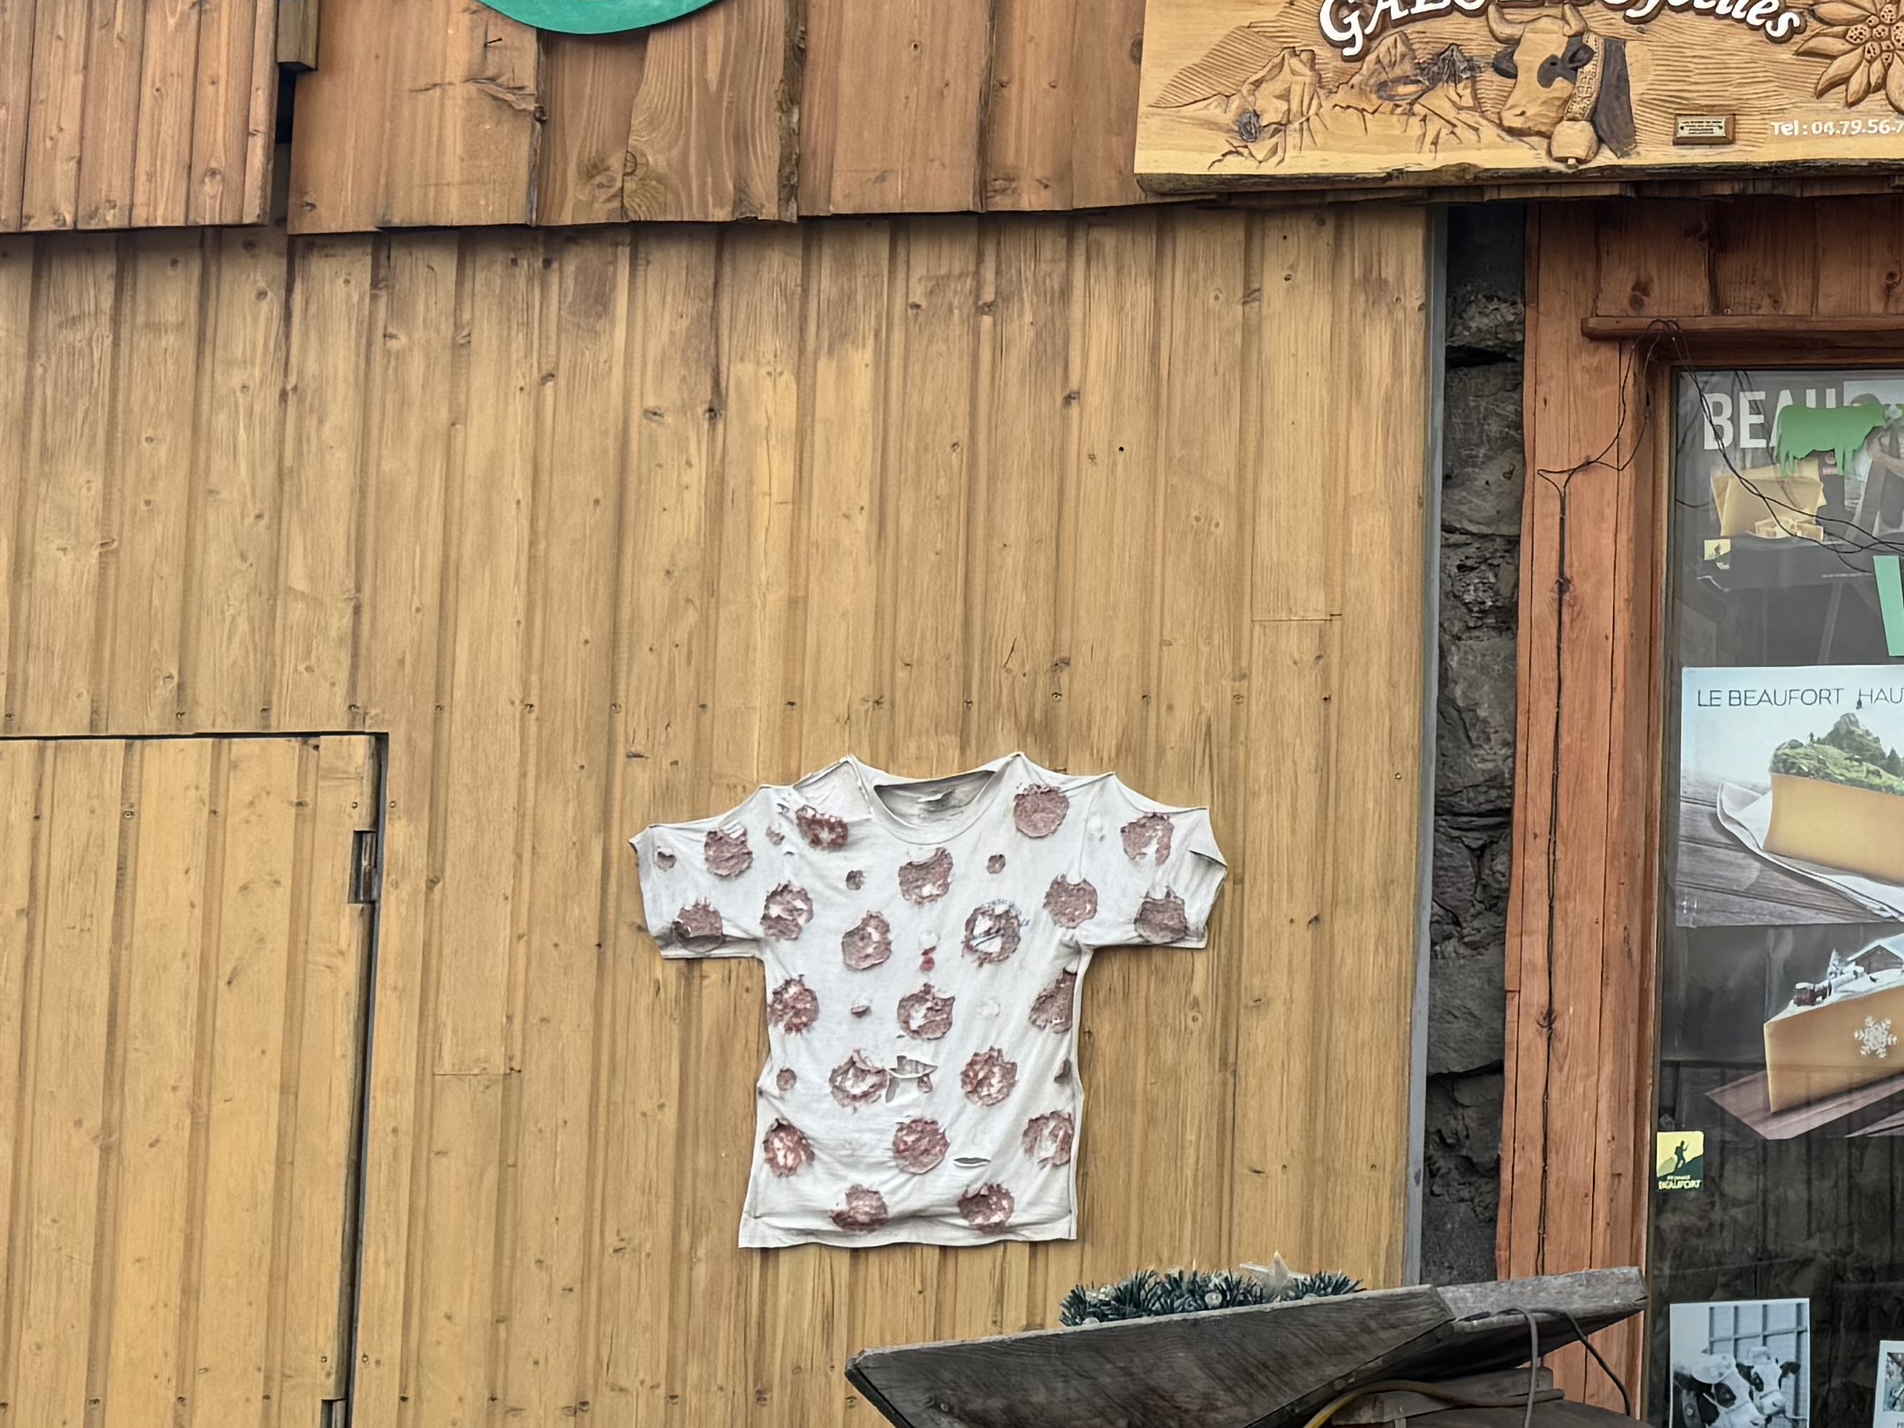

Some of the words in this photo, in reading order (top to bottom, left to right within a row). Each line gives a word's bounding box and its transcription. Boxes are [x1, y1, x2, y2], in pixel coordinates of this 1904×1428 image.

[1703, 388, 1836, 450] BE
[1697, 689, 1725, 707] LE
[1728, 687, 1845, 707] BEAUFORT
